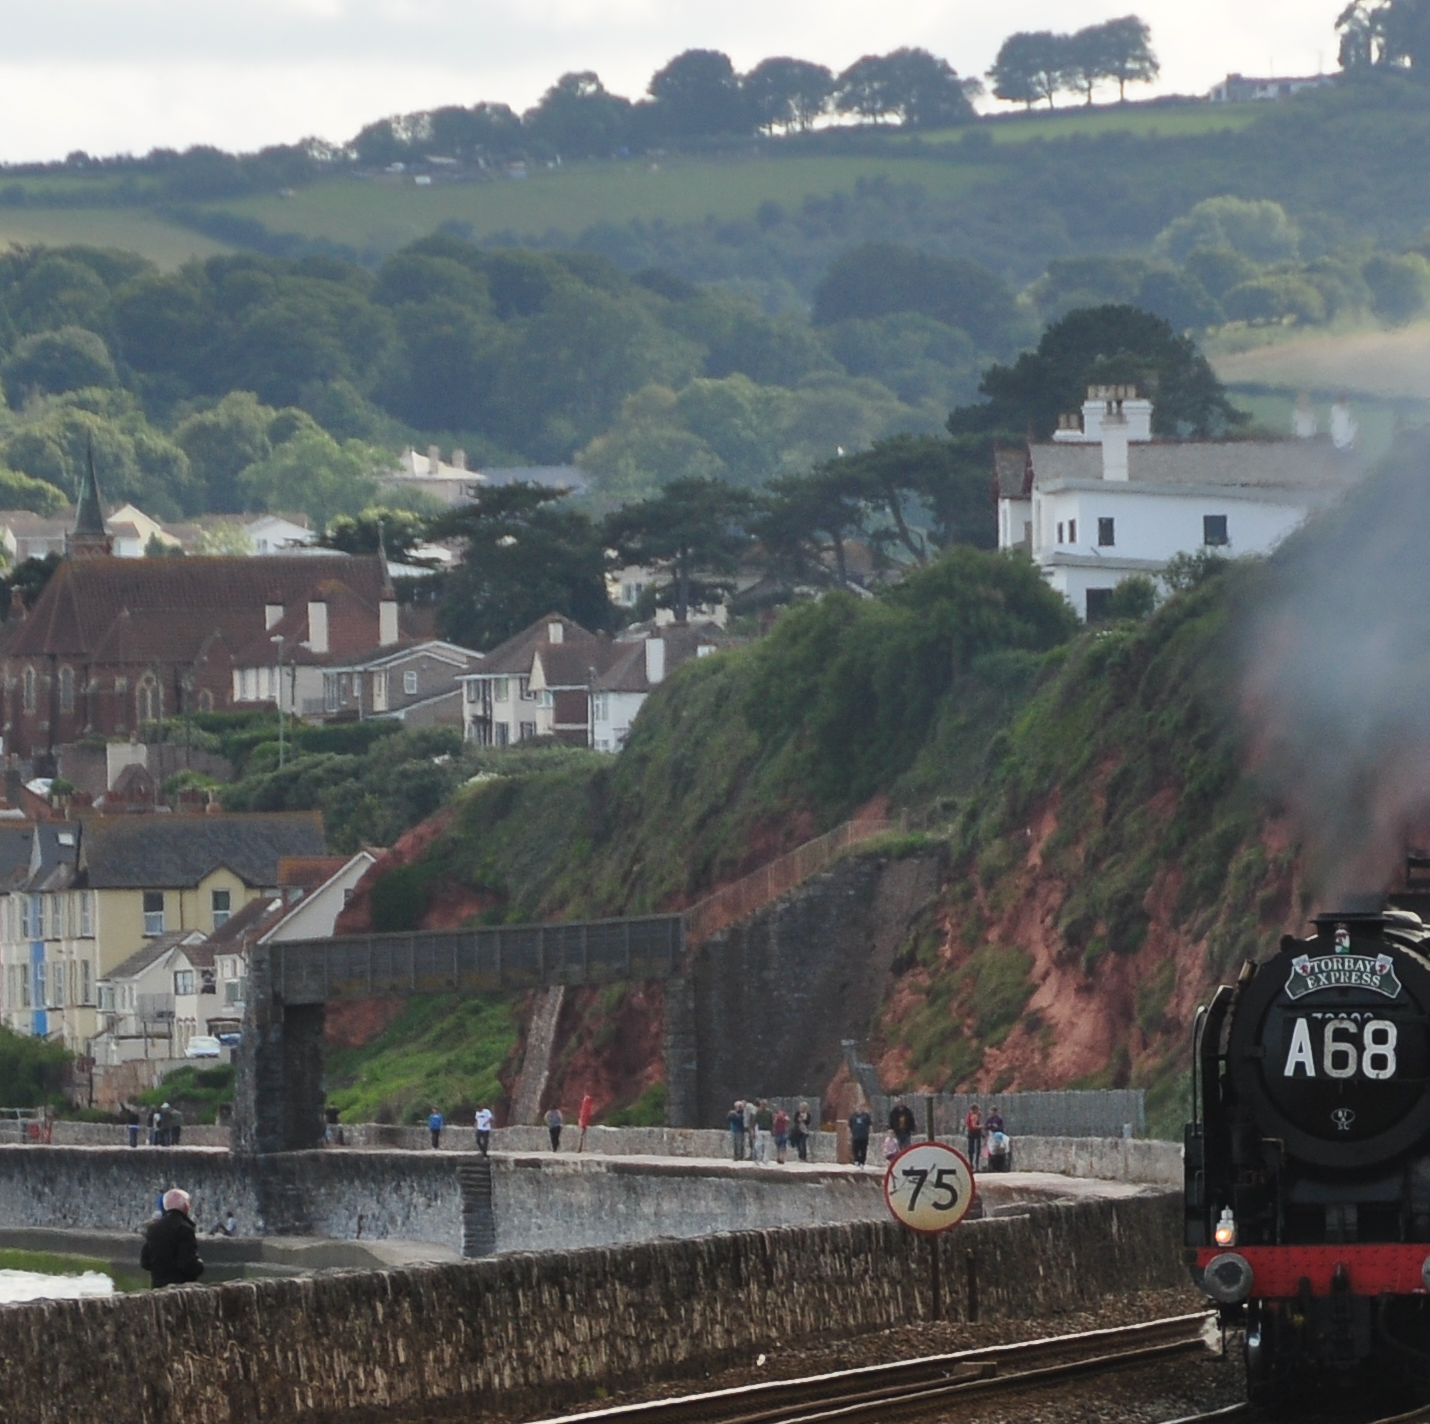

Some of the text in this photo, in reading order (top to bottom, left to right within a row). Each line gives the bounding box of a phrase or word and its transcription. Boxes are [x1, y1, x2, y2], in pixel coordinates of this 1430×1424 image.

[1306, 971, 1381, 989] EXPRESS
[1310, 957, 1375, 973] TORBAY
[1283, 1017, 1398, 1080] A68
[902, 1168, 958, 1212] 75
